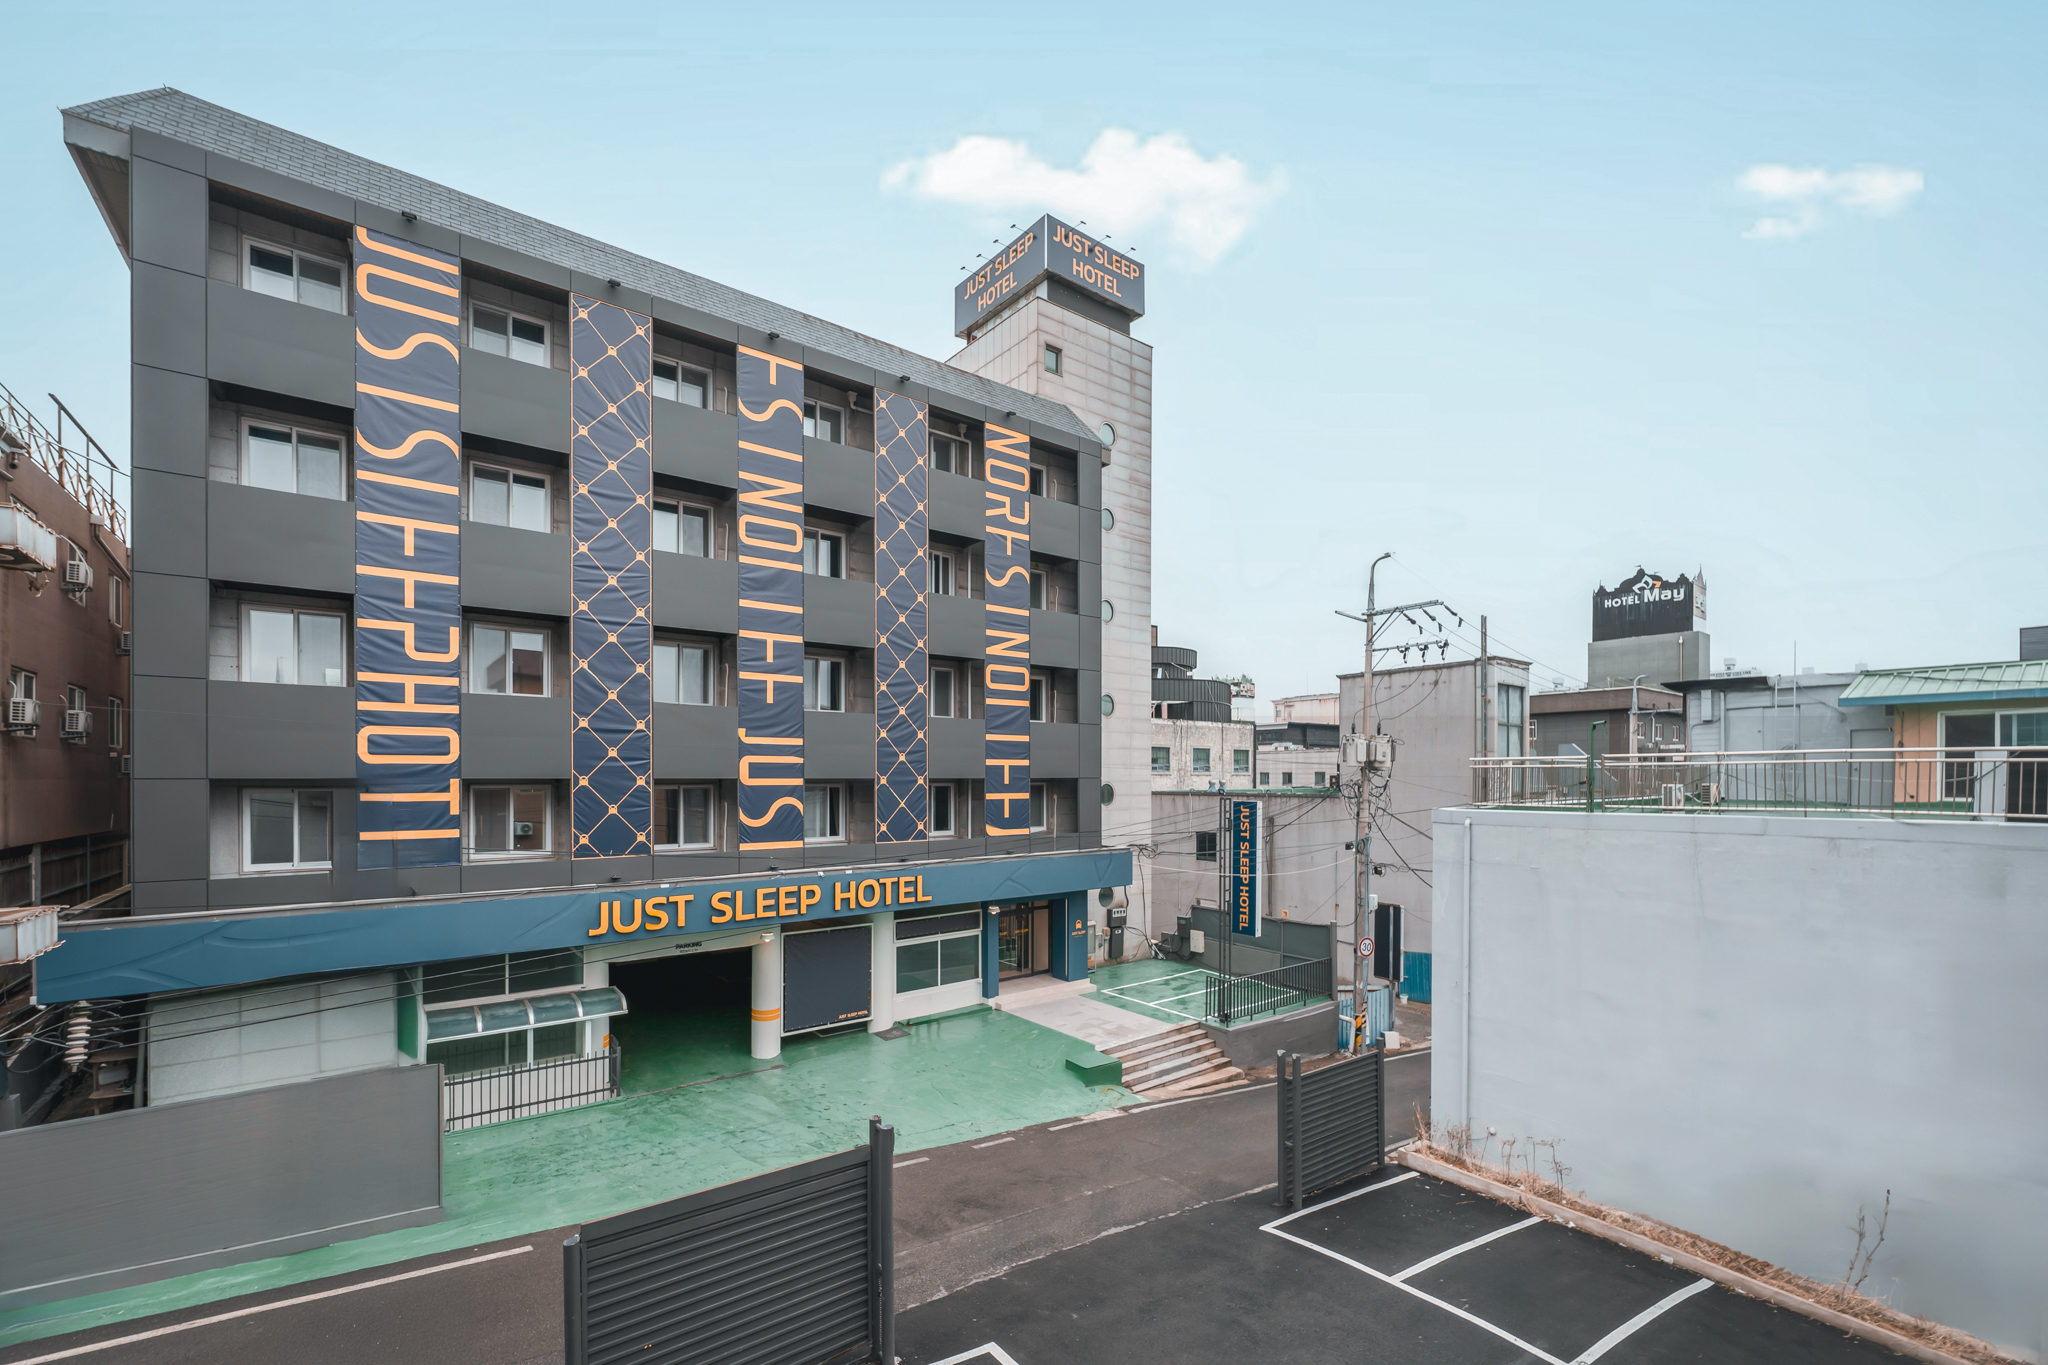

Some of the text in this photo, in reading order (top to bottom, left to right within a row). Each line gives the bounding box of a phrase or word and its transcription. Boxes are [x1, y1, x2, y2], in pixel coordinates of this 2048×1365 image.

[964, 232, 1034, 300] JUST SLEEP
[1053, 225, 1140, 280] JUST SLEEP
[977, 271, 1018, 312] HOTEL
[1072, 258, 1122, 297] HOTEL
[1604, 587, 1685, 608] HOTEL May
[1239, 804, 1250, 931] JUST SLEEP HOTEL
[588, 874, 933, 937] JUST SLEEP HOTEL
[1362, 942, 1372, 952] 30
